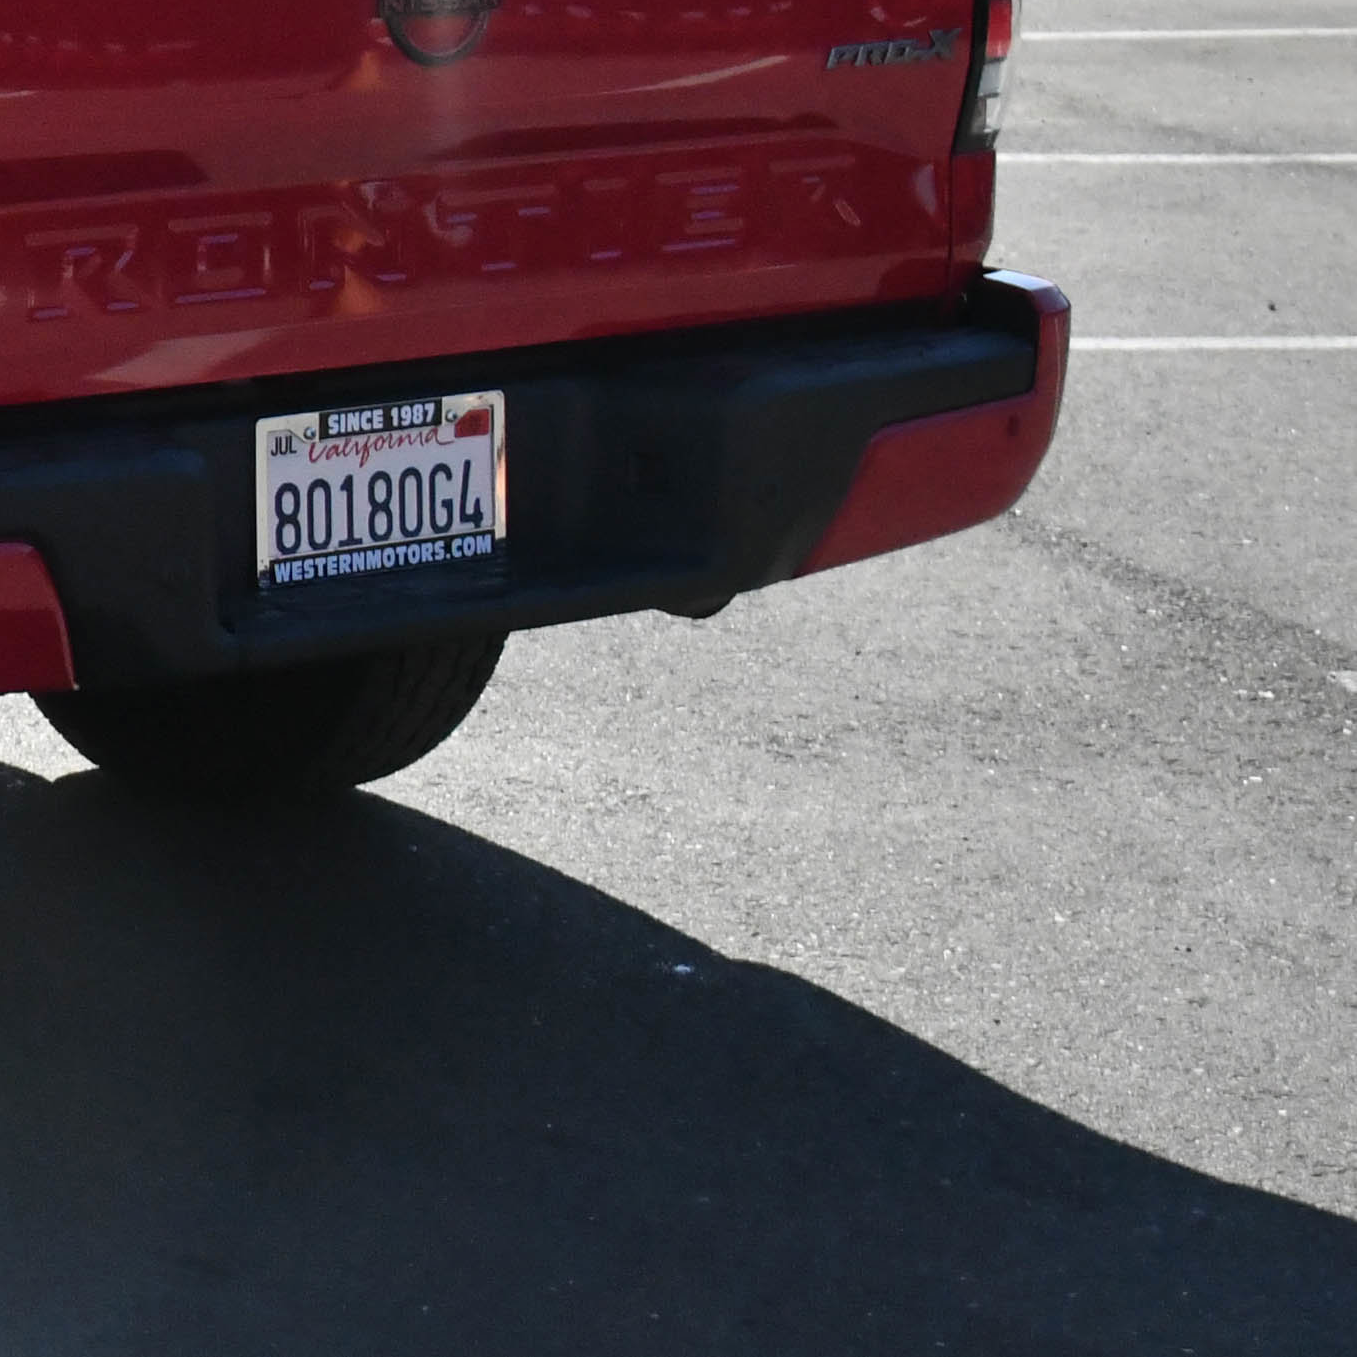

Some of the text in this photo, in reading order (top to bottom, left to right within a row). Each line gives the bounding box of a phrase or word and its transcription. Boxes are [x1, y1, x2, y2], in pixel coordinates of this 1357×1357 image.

[328, 409, 384, 435] SINCE
[390, 403, 435, 427] 1987
[271, 435, 297, 457] JUL
[308, 424, 455, 468] California
[273, 459, 484, 555] 80180G4
[274, 535, 492, 584] WESTERNMOTORS.COM
